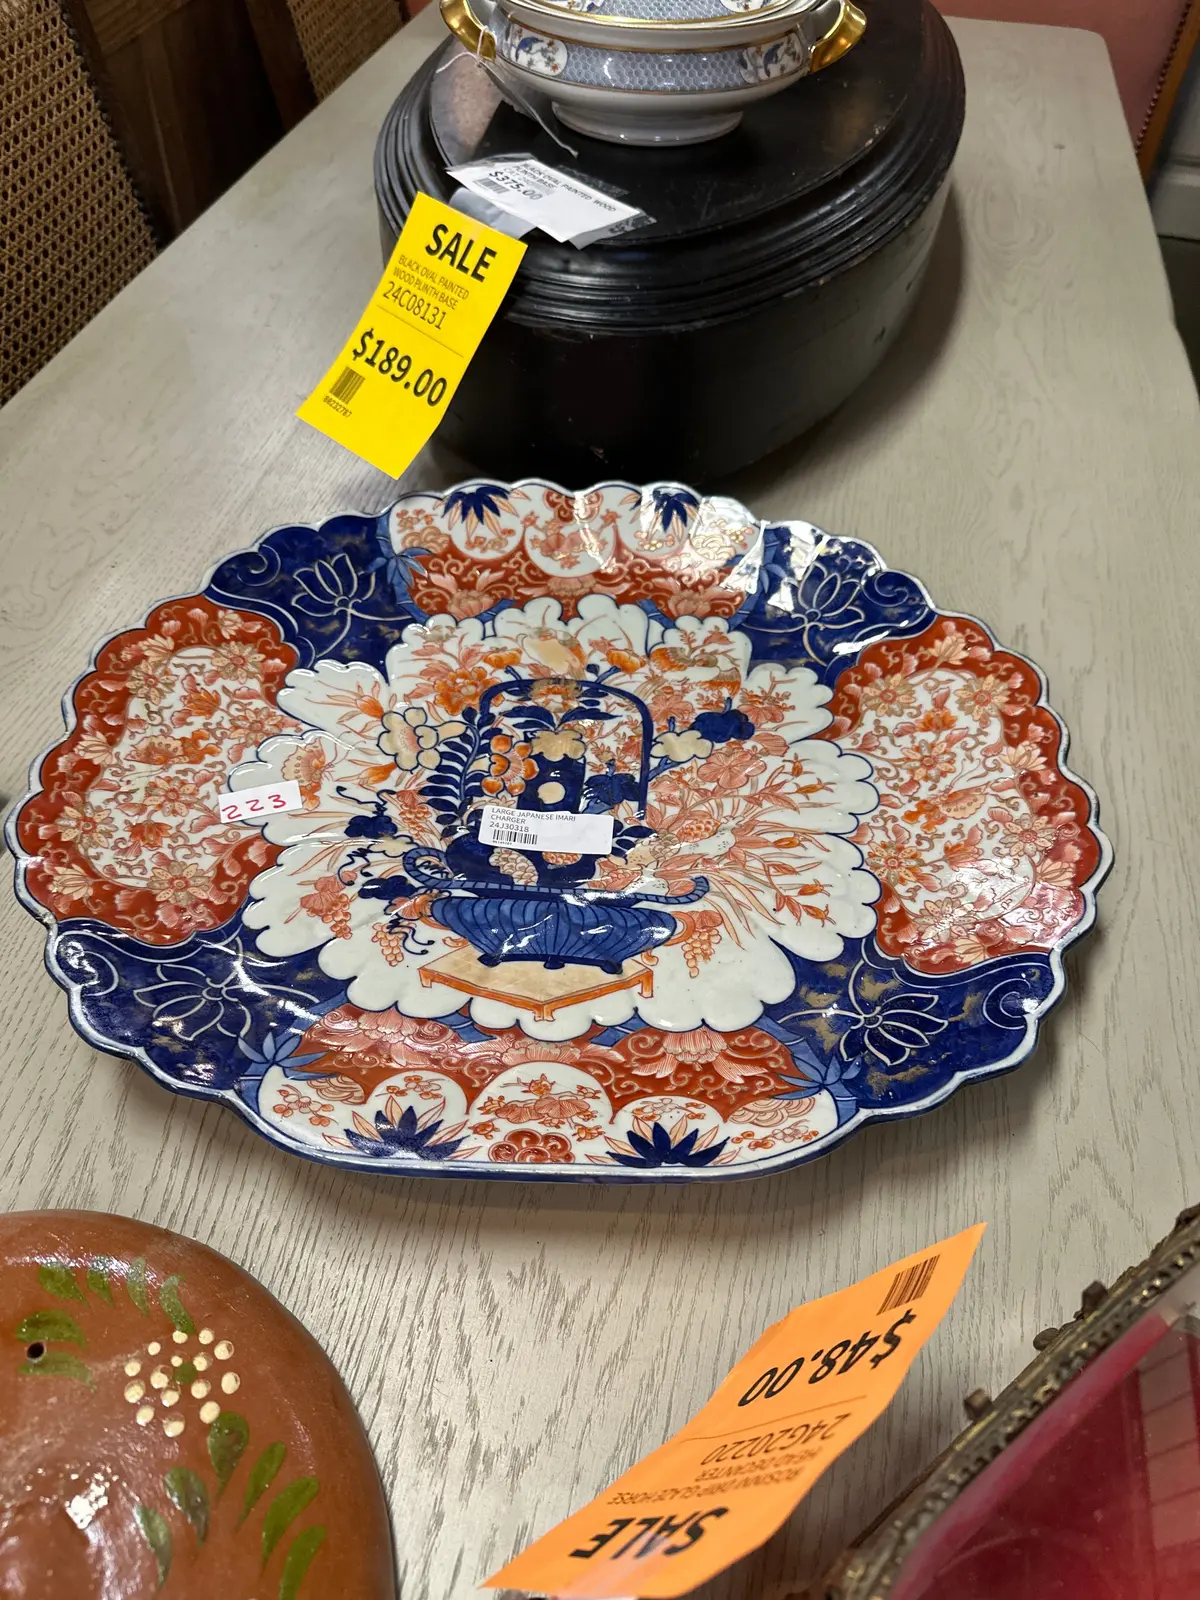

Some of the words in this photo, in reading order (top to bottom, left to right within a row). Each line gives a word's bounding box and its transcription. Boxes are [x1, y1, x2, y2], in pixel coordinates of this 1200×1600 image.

[488, 170, 543, 201] $375.00
[561, 183, 593, 201] PAINTED
[593, 198, 617, 212] WOOD
[425, 223, 497, 283] SALE
[393, 266, 415, 286] WOOD
[414, 278, 440, 299] PLINTH
[438, 292, 459, 311] BASE
[398, 254, 421, 273] BLACK
[420, 266, 438, 284] OVAL
[437, 276, 470, 301] PAINTED
[383, 280, 447, 330] 24C08131
[353, 327, 447, 407] $189.00
[221, 794, 287, 820] 223
[489, 821, 530, 833] 24J30318
[490, 814, 526, 825] CHARGER
[492, 807, 516, 817] LARGE
[517, 810, 553, 821] JAPANESE
[555, 814, 576, 822] IMARI
[738, 1308, 917, 1407] $48.00
[700, 1412, 852, 1466] 24G20220
[568, 1506, 730, 1560] SALE
